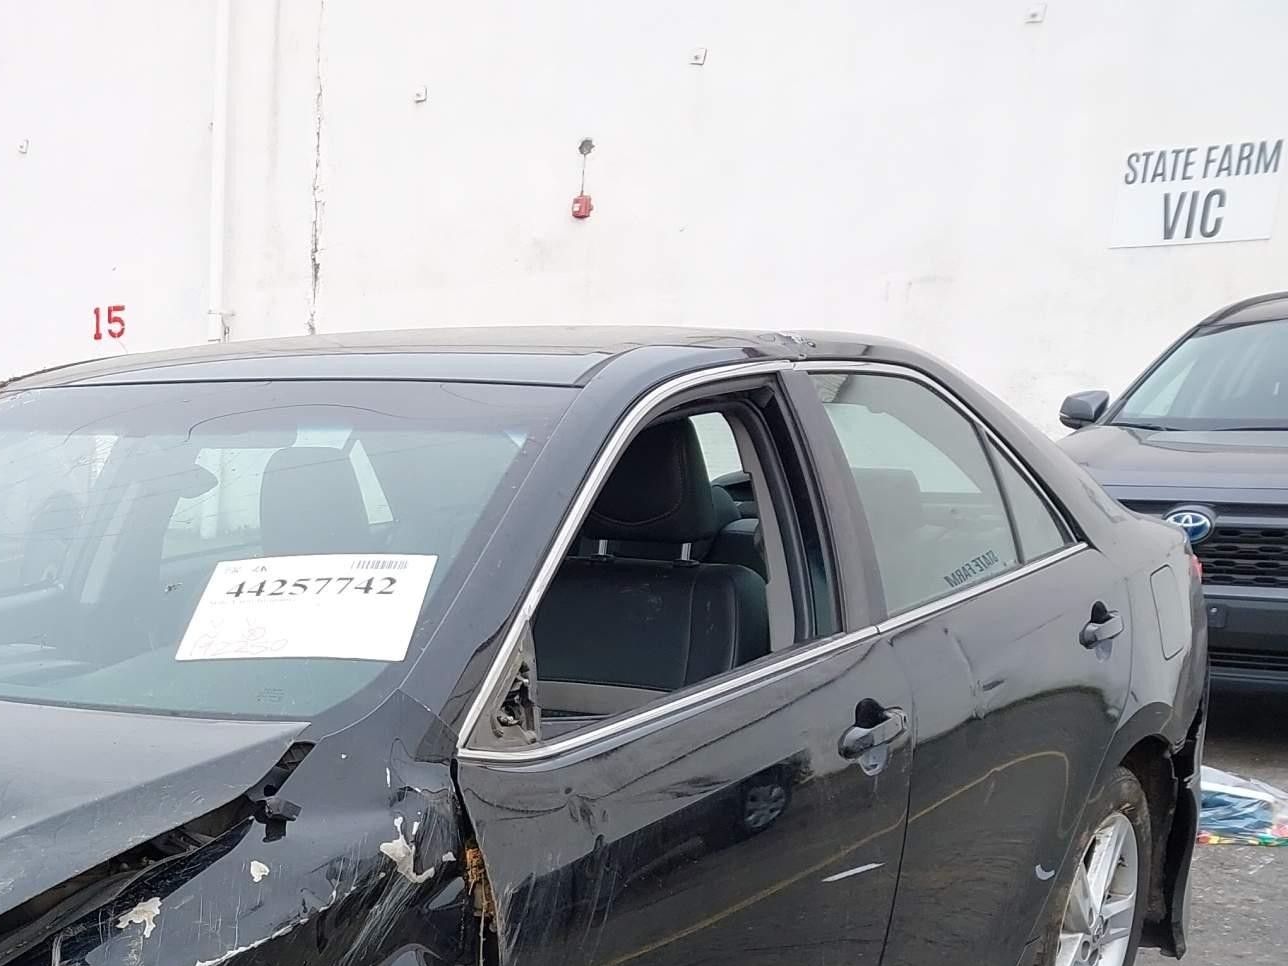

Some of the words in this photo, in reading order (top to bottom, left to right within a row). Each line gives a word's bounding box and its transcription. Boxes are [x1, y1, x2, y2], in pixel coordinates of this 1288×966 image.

[1124, 147, 1198, 185] STATE
[1202, 139, 1284, 179] FARM
[1163, 188, 1227, 240] VIC
[93, 304, 125, 340] 15
[226, 576, 398, 598] 44257742
